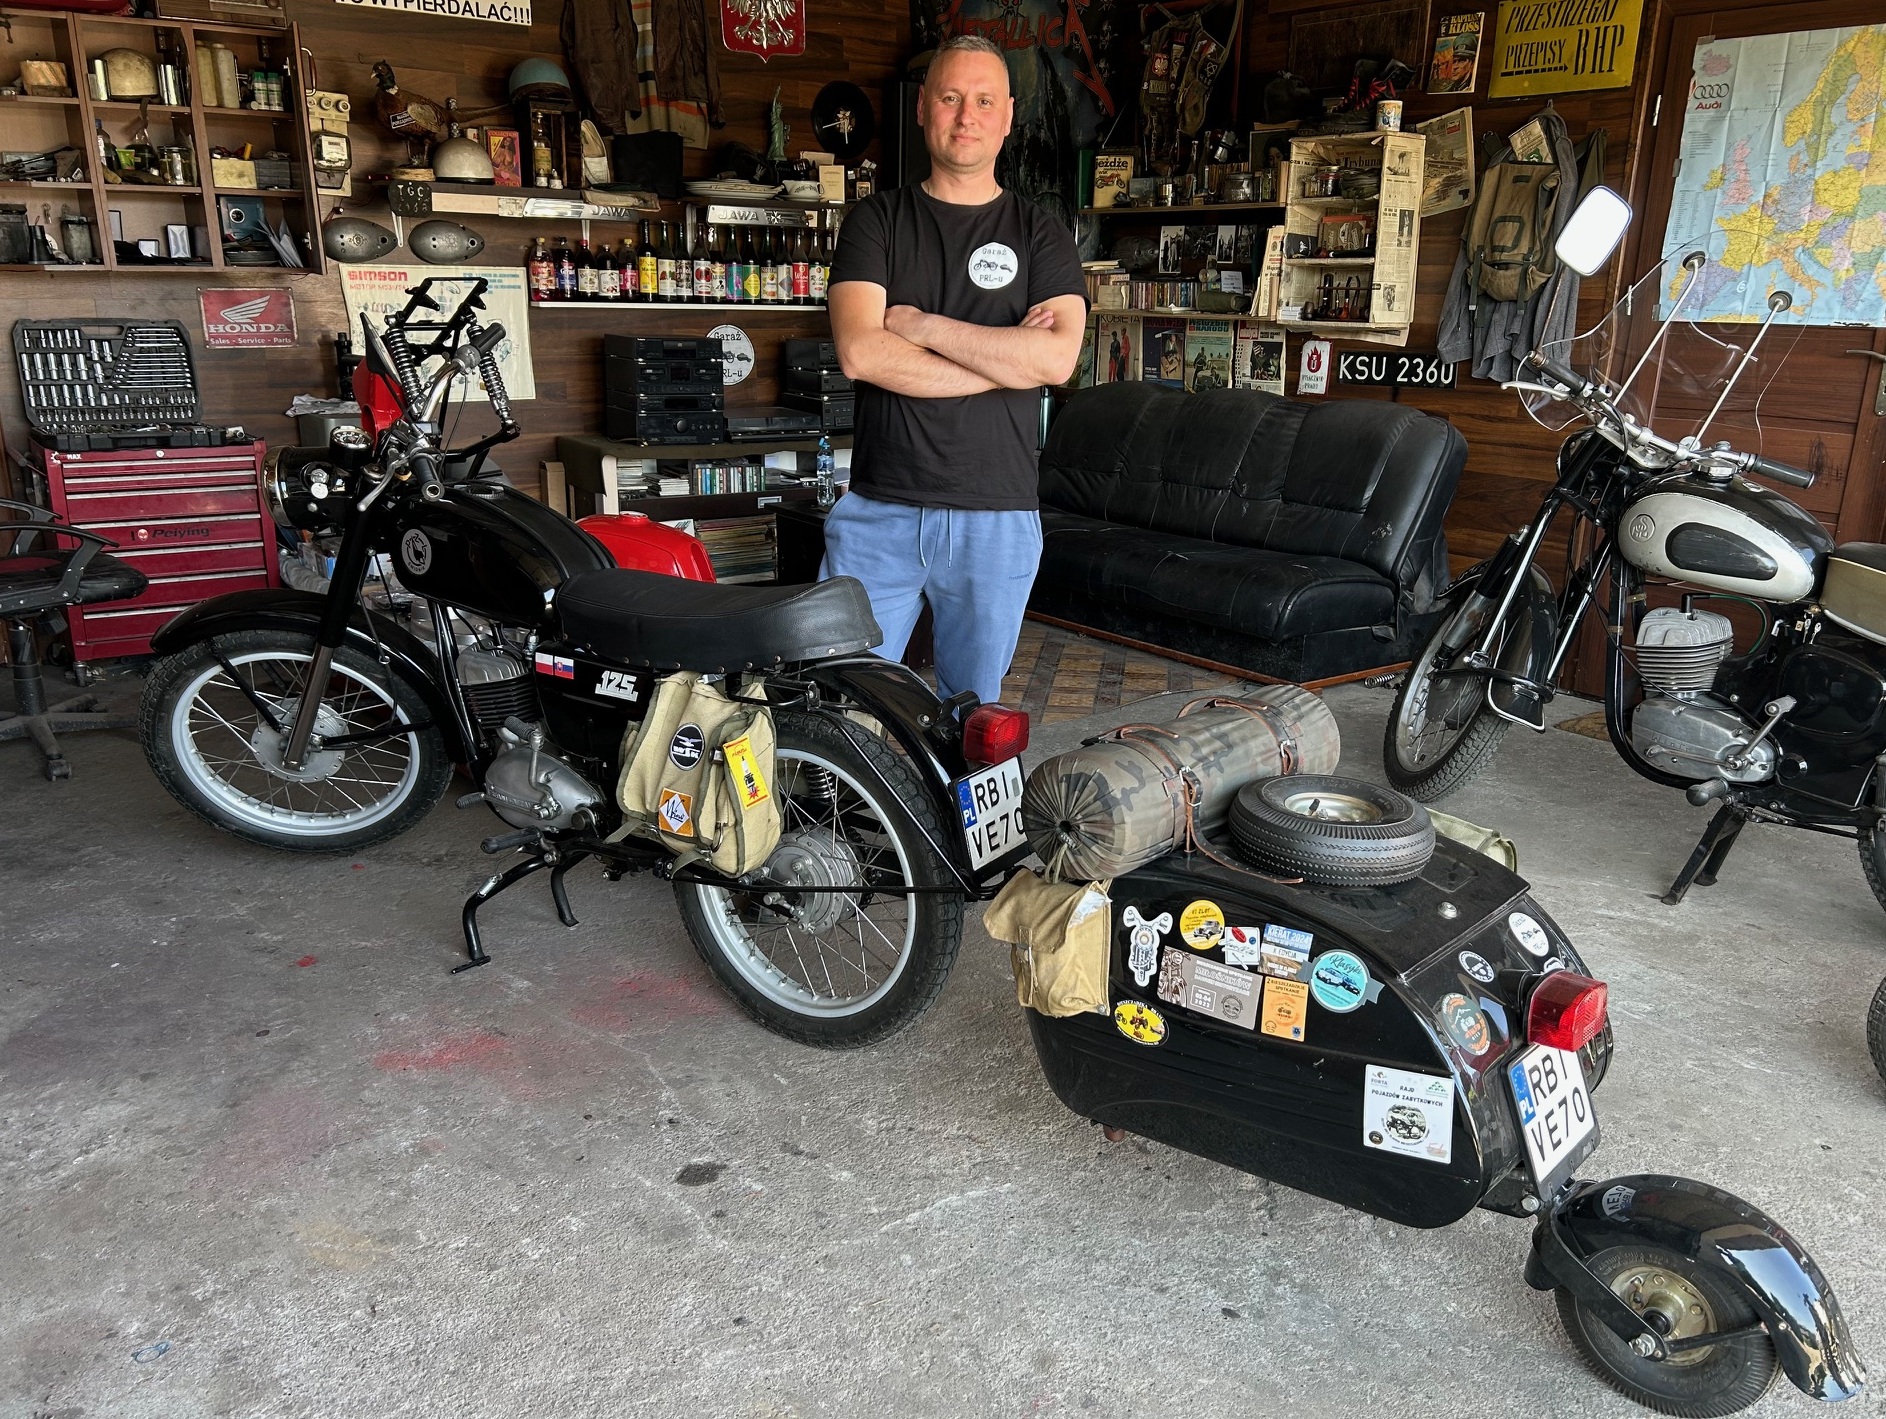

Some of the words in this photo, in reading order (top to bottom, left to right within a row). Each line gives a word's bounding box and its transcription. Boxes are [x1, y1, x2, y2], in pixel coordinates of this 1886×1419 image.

[1449, 22, 1479, 34] KLOSS
[1505, 39, 1566, 69] PRZEPISY
[1573, 24, 1625, 75] BHP
[1695, 101, 1722, 111] Audi
[590, 205, 630, 217] JAWA
[719, 210, 757, 221] JAWA
[348, 270, 408, 282] simson
[208, 323, 291, 333] HONDA
[722, 368, 743, 378] RL-u
[1339, 355, 1387, 380] KSU
[151, 528, 211, 540] Peiying
[598, 670, 638, 701] 125
[974, 771, 1009, 815] RBI
[963, 808, 976, 824] PL
[972, 807, 1025, 859] VE70
[1267, 926, 1291, 941] KIERAT
[1291, 932, 1309, 945] 2024
[1399, 1085, 1415, 1093] RAJD
[1371, 1088, 1400, 1099] POJAZDÓW
[1401, 1094, 1443, 1107] ZABYTKOWYCH
[1520, 1098, 1534, 1120] PL
[1531, 1087, 1585, 1162] VE70
